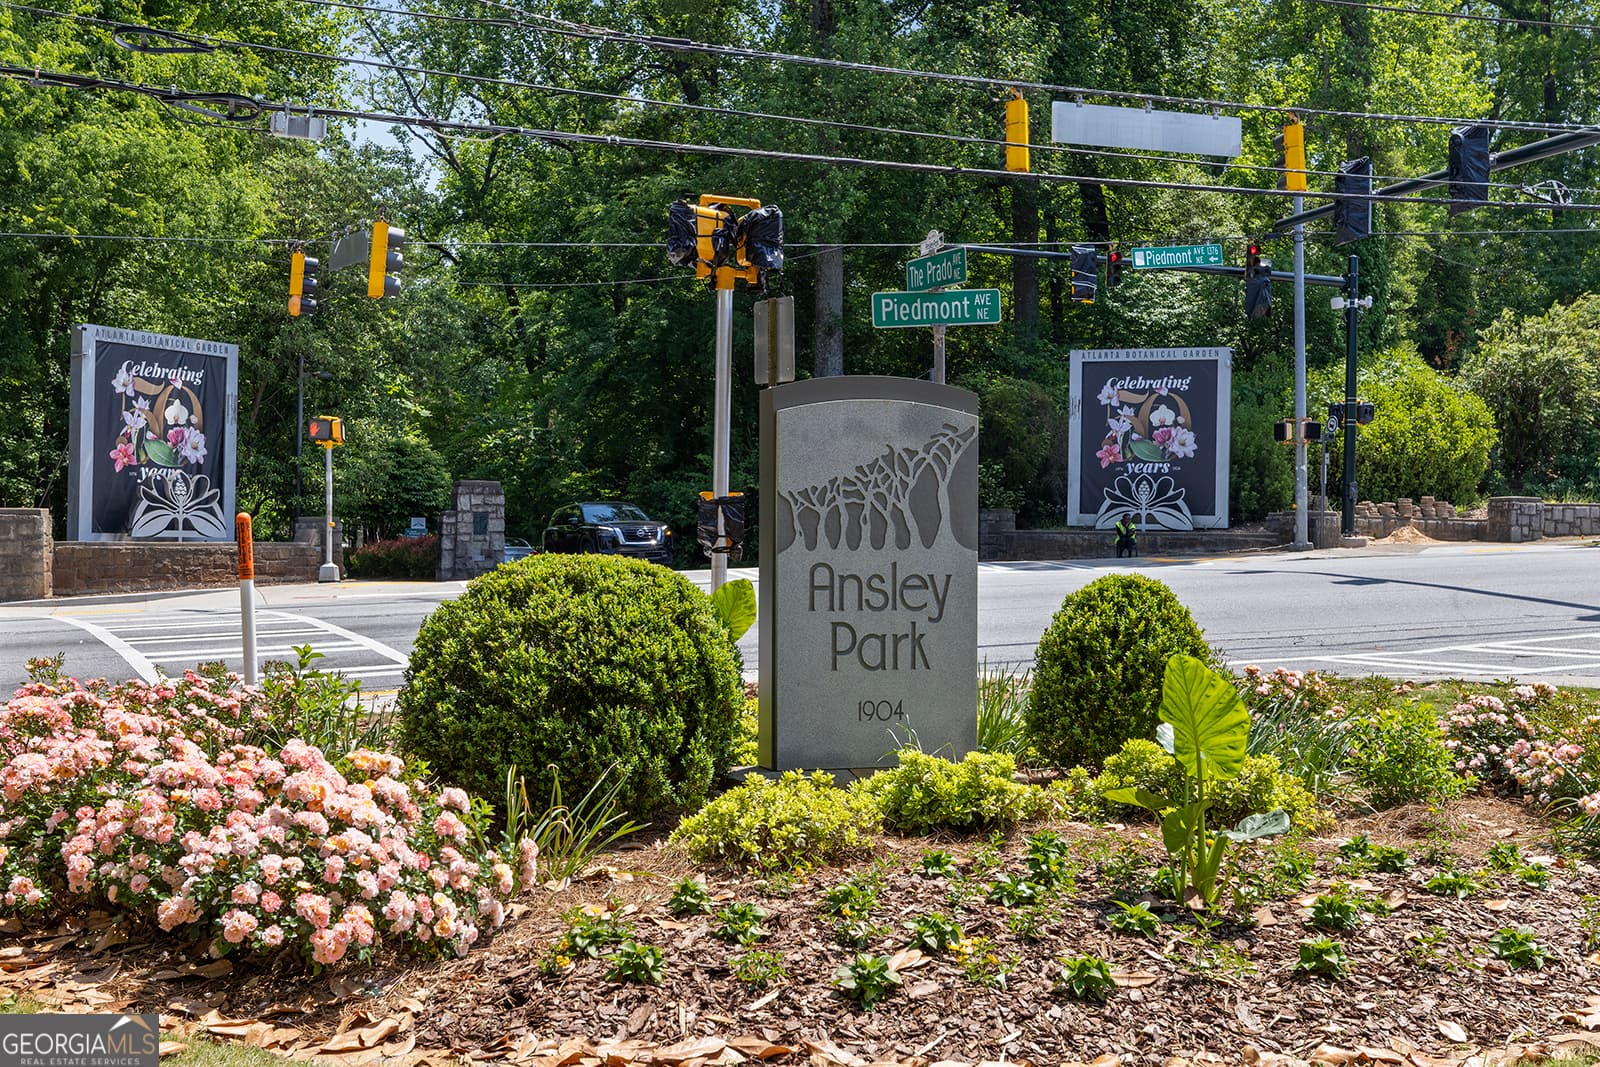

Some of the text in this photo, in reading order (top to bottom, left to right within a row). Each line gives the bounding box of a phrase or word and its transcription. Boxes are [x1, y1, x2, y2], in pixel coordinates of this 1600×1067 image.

[1145, 246, 1219, 266] Piedmont AVE 1376
[909, 265, 923, 288] The
[926, 258, 953, 283] Prado
[953, 267, 961, 280] NE
[881, 293, 992, 321] Piedmont AVE
[976, 308, 990, 320] NE
[141, 333, 191, 351] BOTANICAL
[195, 342, 229, 355] GARDEN
[1081, 347, 1220, 360] ATLANTA BOTANICAL GARDEN
[121, 359, 205, 386] Celebrating
[1106, 375, 1192, 391] Celebrating
[136, 466, 183, 484] year
[1123, 462, 1170, 476] years
[807, 561, 953, 624] Ansley
[830, 621, 931, 671] Park
[857, 699, 905, 722] 1904
